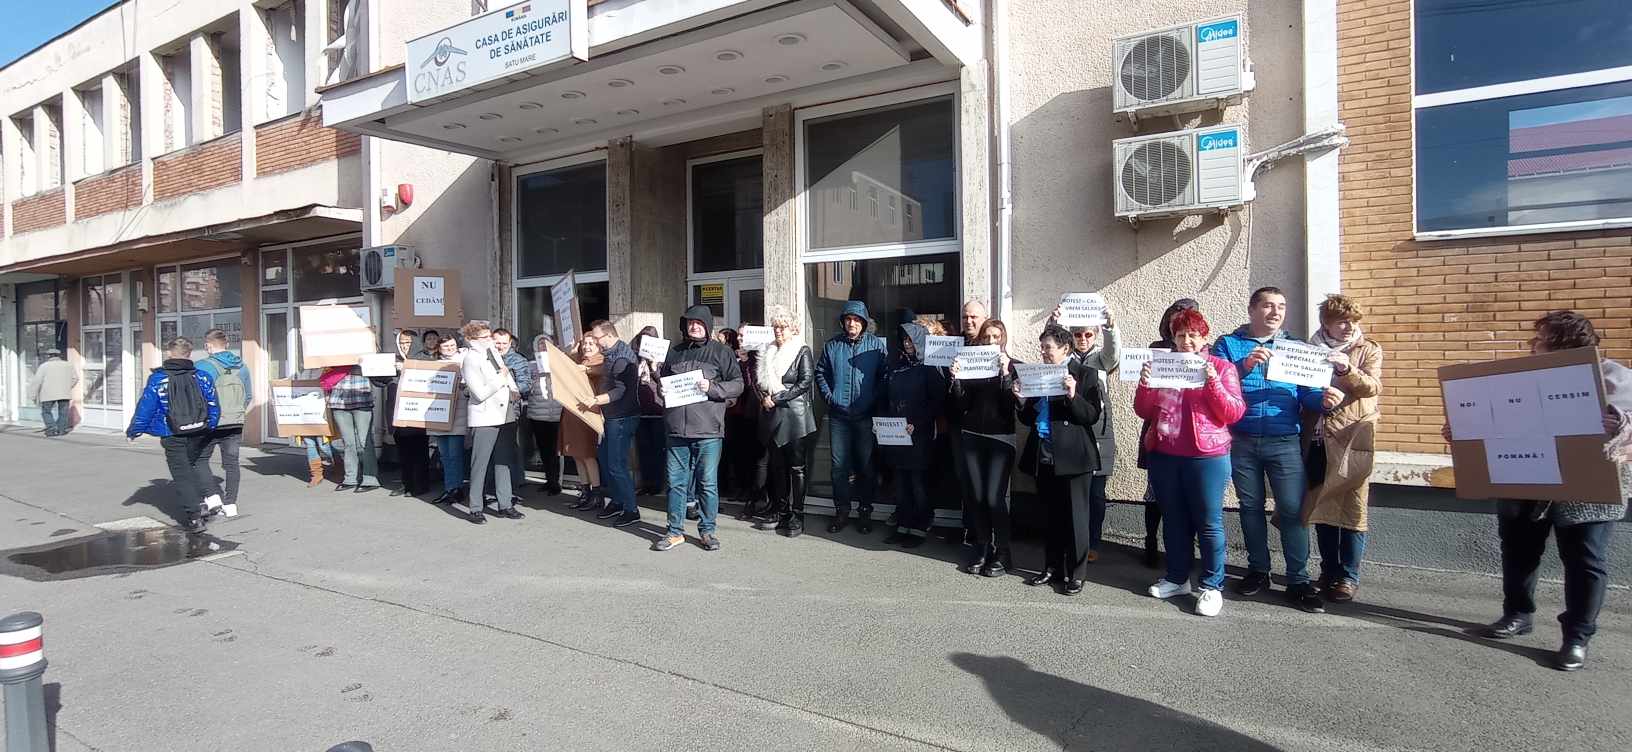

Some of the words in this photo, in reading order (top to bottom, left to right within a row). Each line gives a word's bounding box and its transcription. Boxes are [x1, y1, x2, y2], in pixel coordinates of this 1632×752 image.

[475, 33, 500, 50] CASA
[501, 28, 513, 42] DE
[1202, 26, 1234, 41] Midea
[489, 45, 503, 59] DE
[503, 31, 552, 55] SĂNĂTATE
[505, 59, 520, 69] SATU
[520, 53, 537, 64] MARE
[414, 60, 467, 94] CNAS
[1202, 136, 1234, 151] Midea
[421, 281, 437, 289] NU
